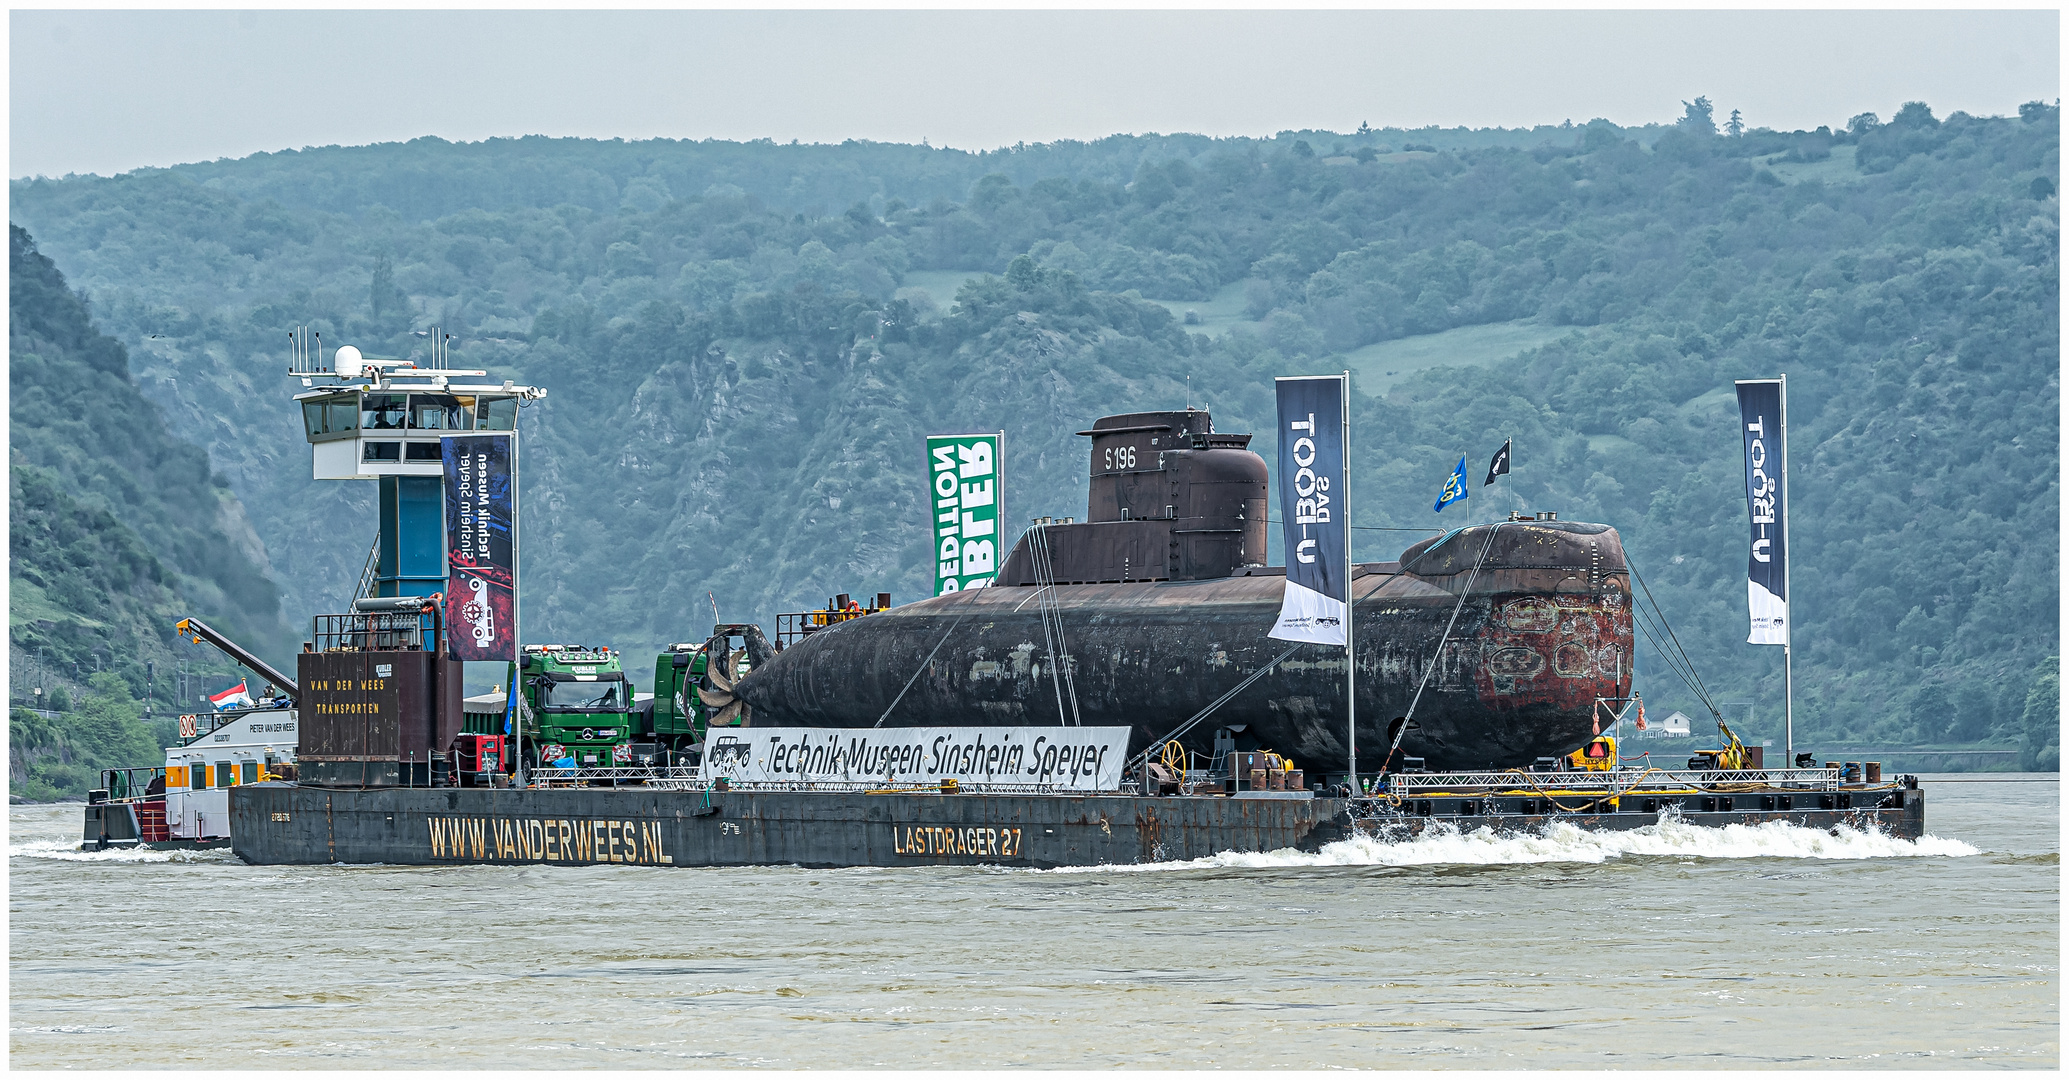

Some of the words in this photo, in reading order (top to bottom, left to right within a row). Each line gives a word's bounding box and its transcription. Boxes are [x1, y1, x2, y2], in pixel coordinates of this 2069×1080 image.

[1105, 447, 1112, 470] S
[1114, 446, 1136, 469] 196
[311, 680, 328, 690] VAN
[337, 680, 352, 690] DER
[361, 680, 384, 690] WEES
[317, 703, 379, 714] TRANSPORTEN
[250, 724, 264, 733] PIETER
[265, 724, 273, 732] VAN
[273, 723, 282, 732] DER
[282, 722, 295, 731] WEES
[766, 733, 842, 774] Technik
[850, 738, 923, 775] Museen
[928, 733, 1024, 775] Sinsheim
[1027, 736, 1108, 787] Speyer
[428, 817, 673, 864] WWW.VANDERWEES.NL
[894, 826, 998, 856] LASTDRAGER
[1001, 828, 1022, 856] 27
